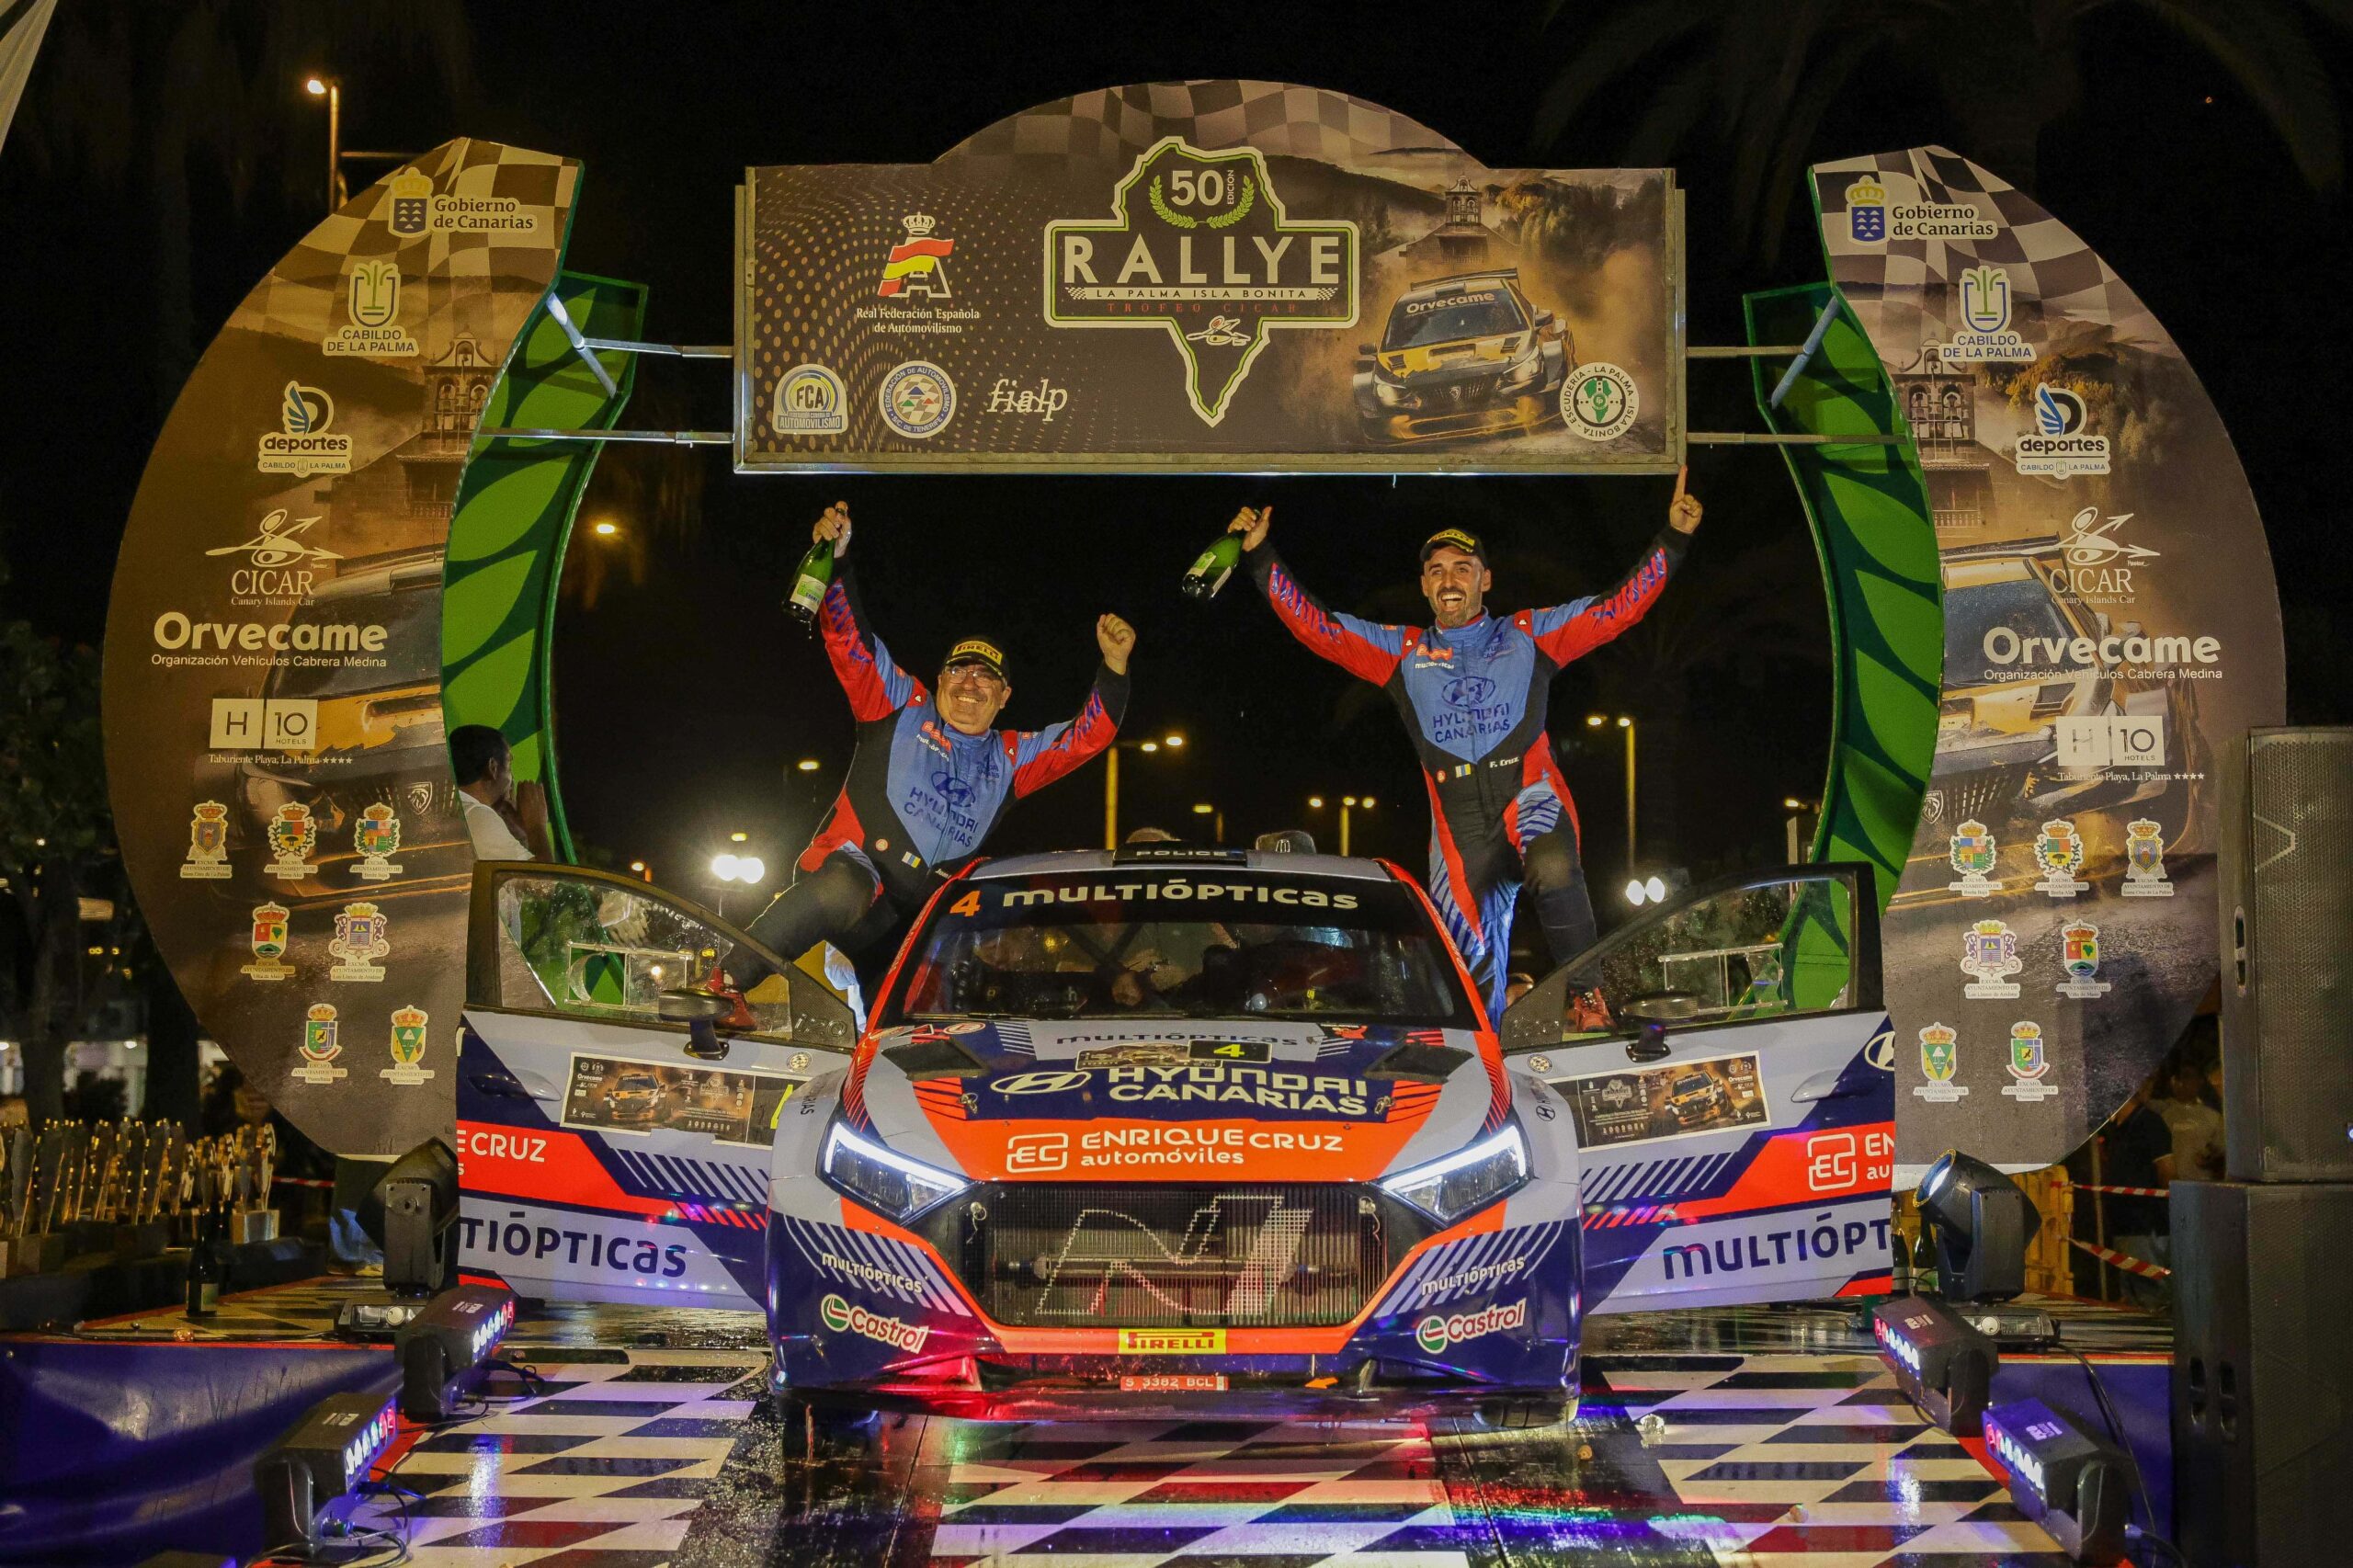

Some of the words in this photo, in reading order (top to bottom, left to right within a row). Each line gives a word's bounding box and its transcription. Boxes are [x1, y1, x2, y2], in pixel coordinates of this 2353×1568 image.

[1171, 169, 1224, 206] 50
[435, 198, 516, 212] Gobierno
[1893, 205, 1974, 220] Gobierno
[434, 214, 453, 229] de
[457, 215, 533, 230] Canarias
[1893, 223, 1915, 235] de
[1917, 222, 1994, 235] Canarias
[1064, 233, 1339, 284] RALLYE
[1097, 290, 1116, 298] LA
[1128, 290, 1181, 298] PALMA
[1194, 290, 1231, 298] ISLA
[1243, 290, 1307, 298] BONITA
[1406, 290, 1495, 314] Orvecame
[856, 308, 877, 319] Real
[880, 308, 933, 319] Federación
[936, 308, 980, 321] Española
[1107, 303, 1201, 312] TROFEO
[1223, 303, 1296, 312] CICAR
[343, 330, 402, 341] CABILDO
[874, 323, 886, 333] de
[888, 323, 962, 334] Automovilismo
[327, 342, 345, 352] DE
[348, 342, 365, 352] LA
[369, 342, 415, 353] PALMA
[1957, 335, 2017, 346] CABILDO
[1943, 347, 1962, 358] DE
[1966, 347, 1984, 358] LA
[1987, 347, 2031, 358] PALMA
[1594, 366, 1607, 374] LA
[916, 367, 951, 412] AUTOMOVILISMO
[1608, 368, 1634, 397] PALMA
[796, 385, 824, 409] FCA
[987, 378, 1068, 422] fialp
[779, 416, 841, 429] AUTOMOVILISMO
[913, 415, 944, 432] TENERIFE
[1622, 406, 1635, 430] ISLA
[1583, 426, 1621, 437] BONITA
[264, 436, 347, 454] deportes
[2020, 438, 2105, 456] deportes
[232, 570, 314, 596] CICAR
[2049, 568, 2134, 593] CICAR
[231, 597, 263, 607] Canary
[266, 597, 296, 607] Islands
[299, 597, 314, 606] Car
[2051, 596, 2084, 606] Canary
[2086, 595, 2117, 604] Islands
[2119, 596, 2135, 604] Car
[153, 612, 388, 651] Orvecame
[1983, 626, 2221, 664] Orvecame
[152, 653, 229, 667] Organización
[232, 654, 290, 666] Vehículos
[293, 655, 340, 666] Cabrera
[344, 656, 387, 667] Medina
[1984, 668, 2062, 681] Organización
[2127, 669, 2176, 679] Cabrera
[2178, 669, 2222, 679] Medina
[226, 711, 248, 736] H
[275, 711, 308, 736] 10
[2120, 728, 2155, 753] 10
[281, 756, 291, 764] La
[2132, 772, 2143, 780] La
[2144, 772, 2171, 780] Palma
[950, 891, 982, 916] 4
[1213, 1044, 1245, 1057] 4
[1108, 1066, 1368, 1096] HYUNDAI
[1109, 1084, 1368, 1115] CANARIAS
[471, 1131, 547, 1163] CRUZ
[1081, 1147, 1244, 1165] automóviles
[1448, 1302, 1525, 1341] Castrol
[851, 1309, 928, 1352] Castrol
[1128, 1332, 1215, 1349] PIRELLI
[1142, 1378, 1179, 1387] 3382
[1187, 1378, 1214, 1387] BCL
